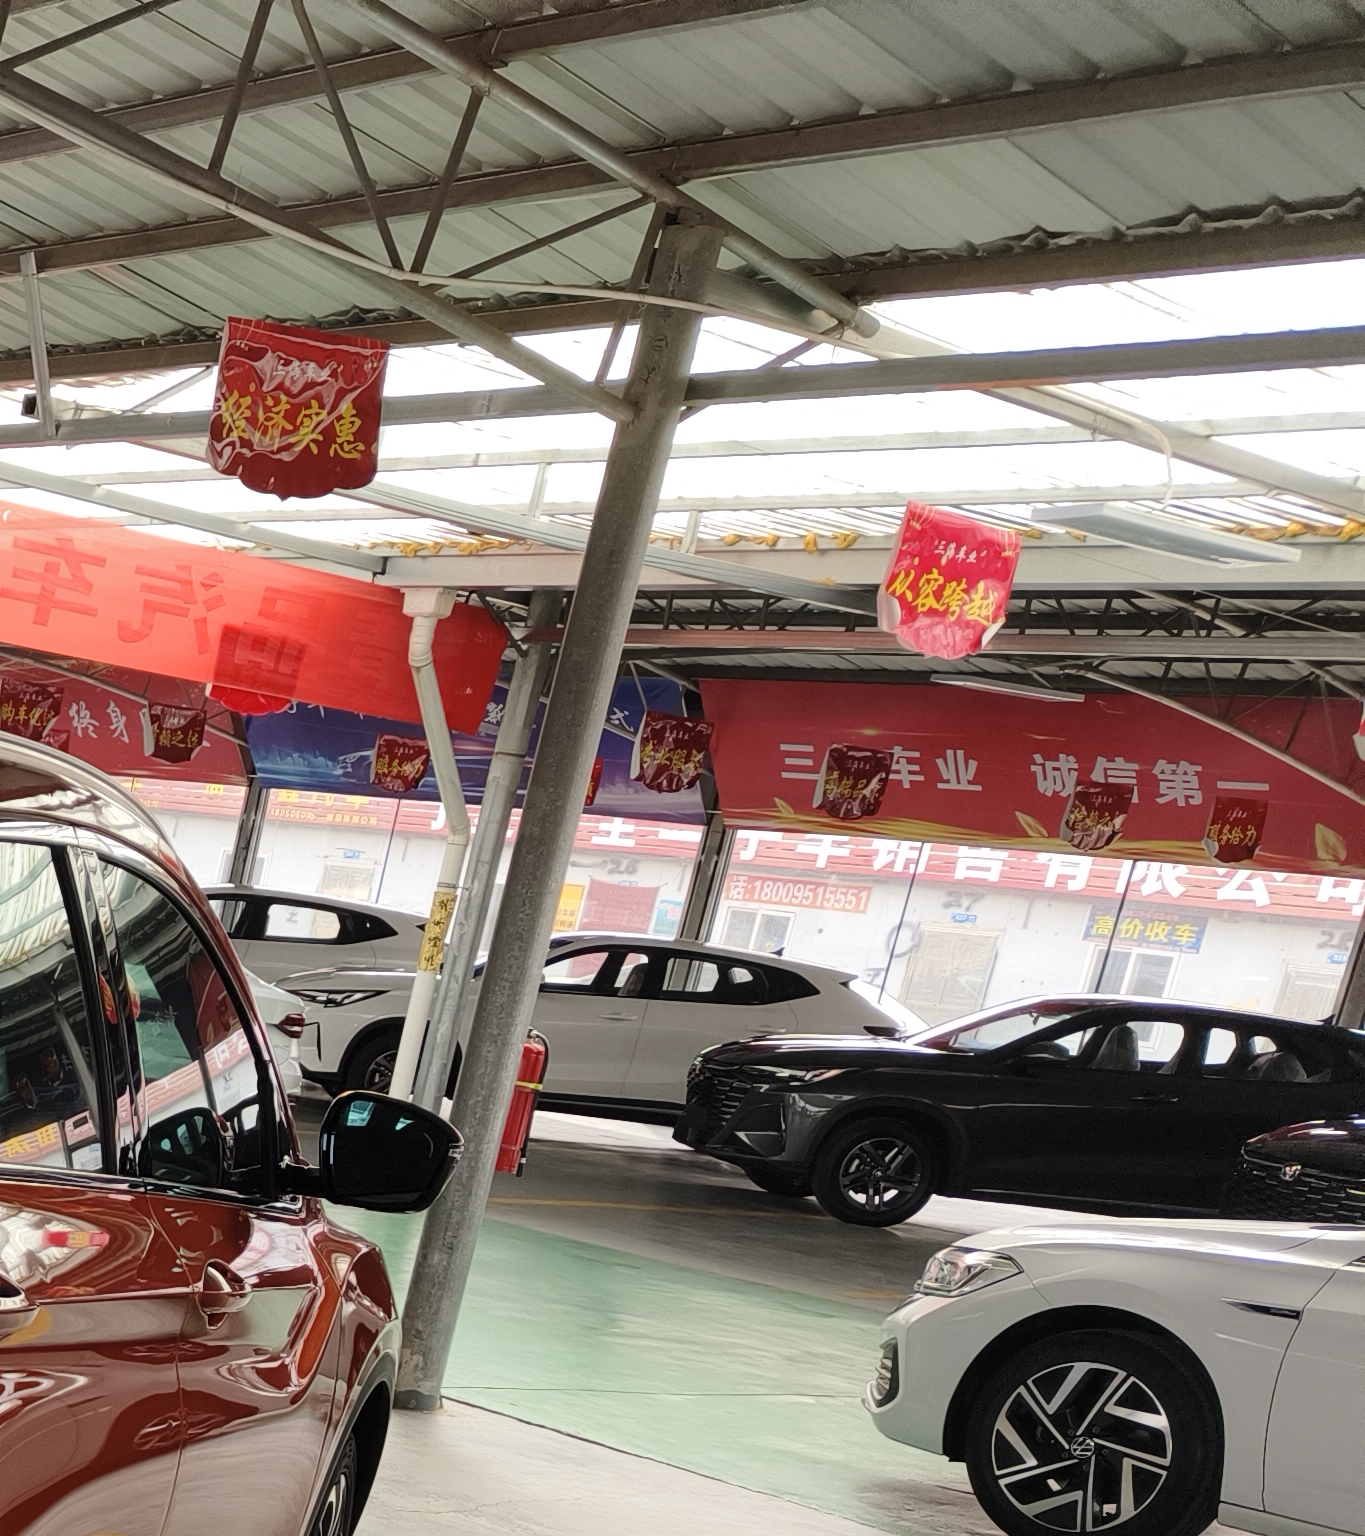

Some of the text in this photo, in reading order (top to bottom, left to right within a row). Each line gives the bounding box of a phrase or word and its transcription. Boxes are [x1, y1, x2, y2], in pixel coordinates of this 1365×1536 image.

[222, 389, 365, 459] 经济实惠
[888, 568, 998, 627] 从容跨越
[780, 743, 1269, 806] 三车业 诚信第一
[1090, 914, 1199, 944] 高价收车
